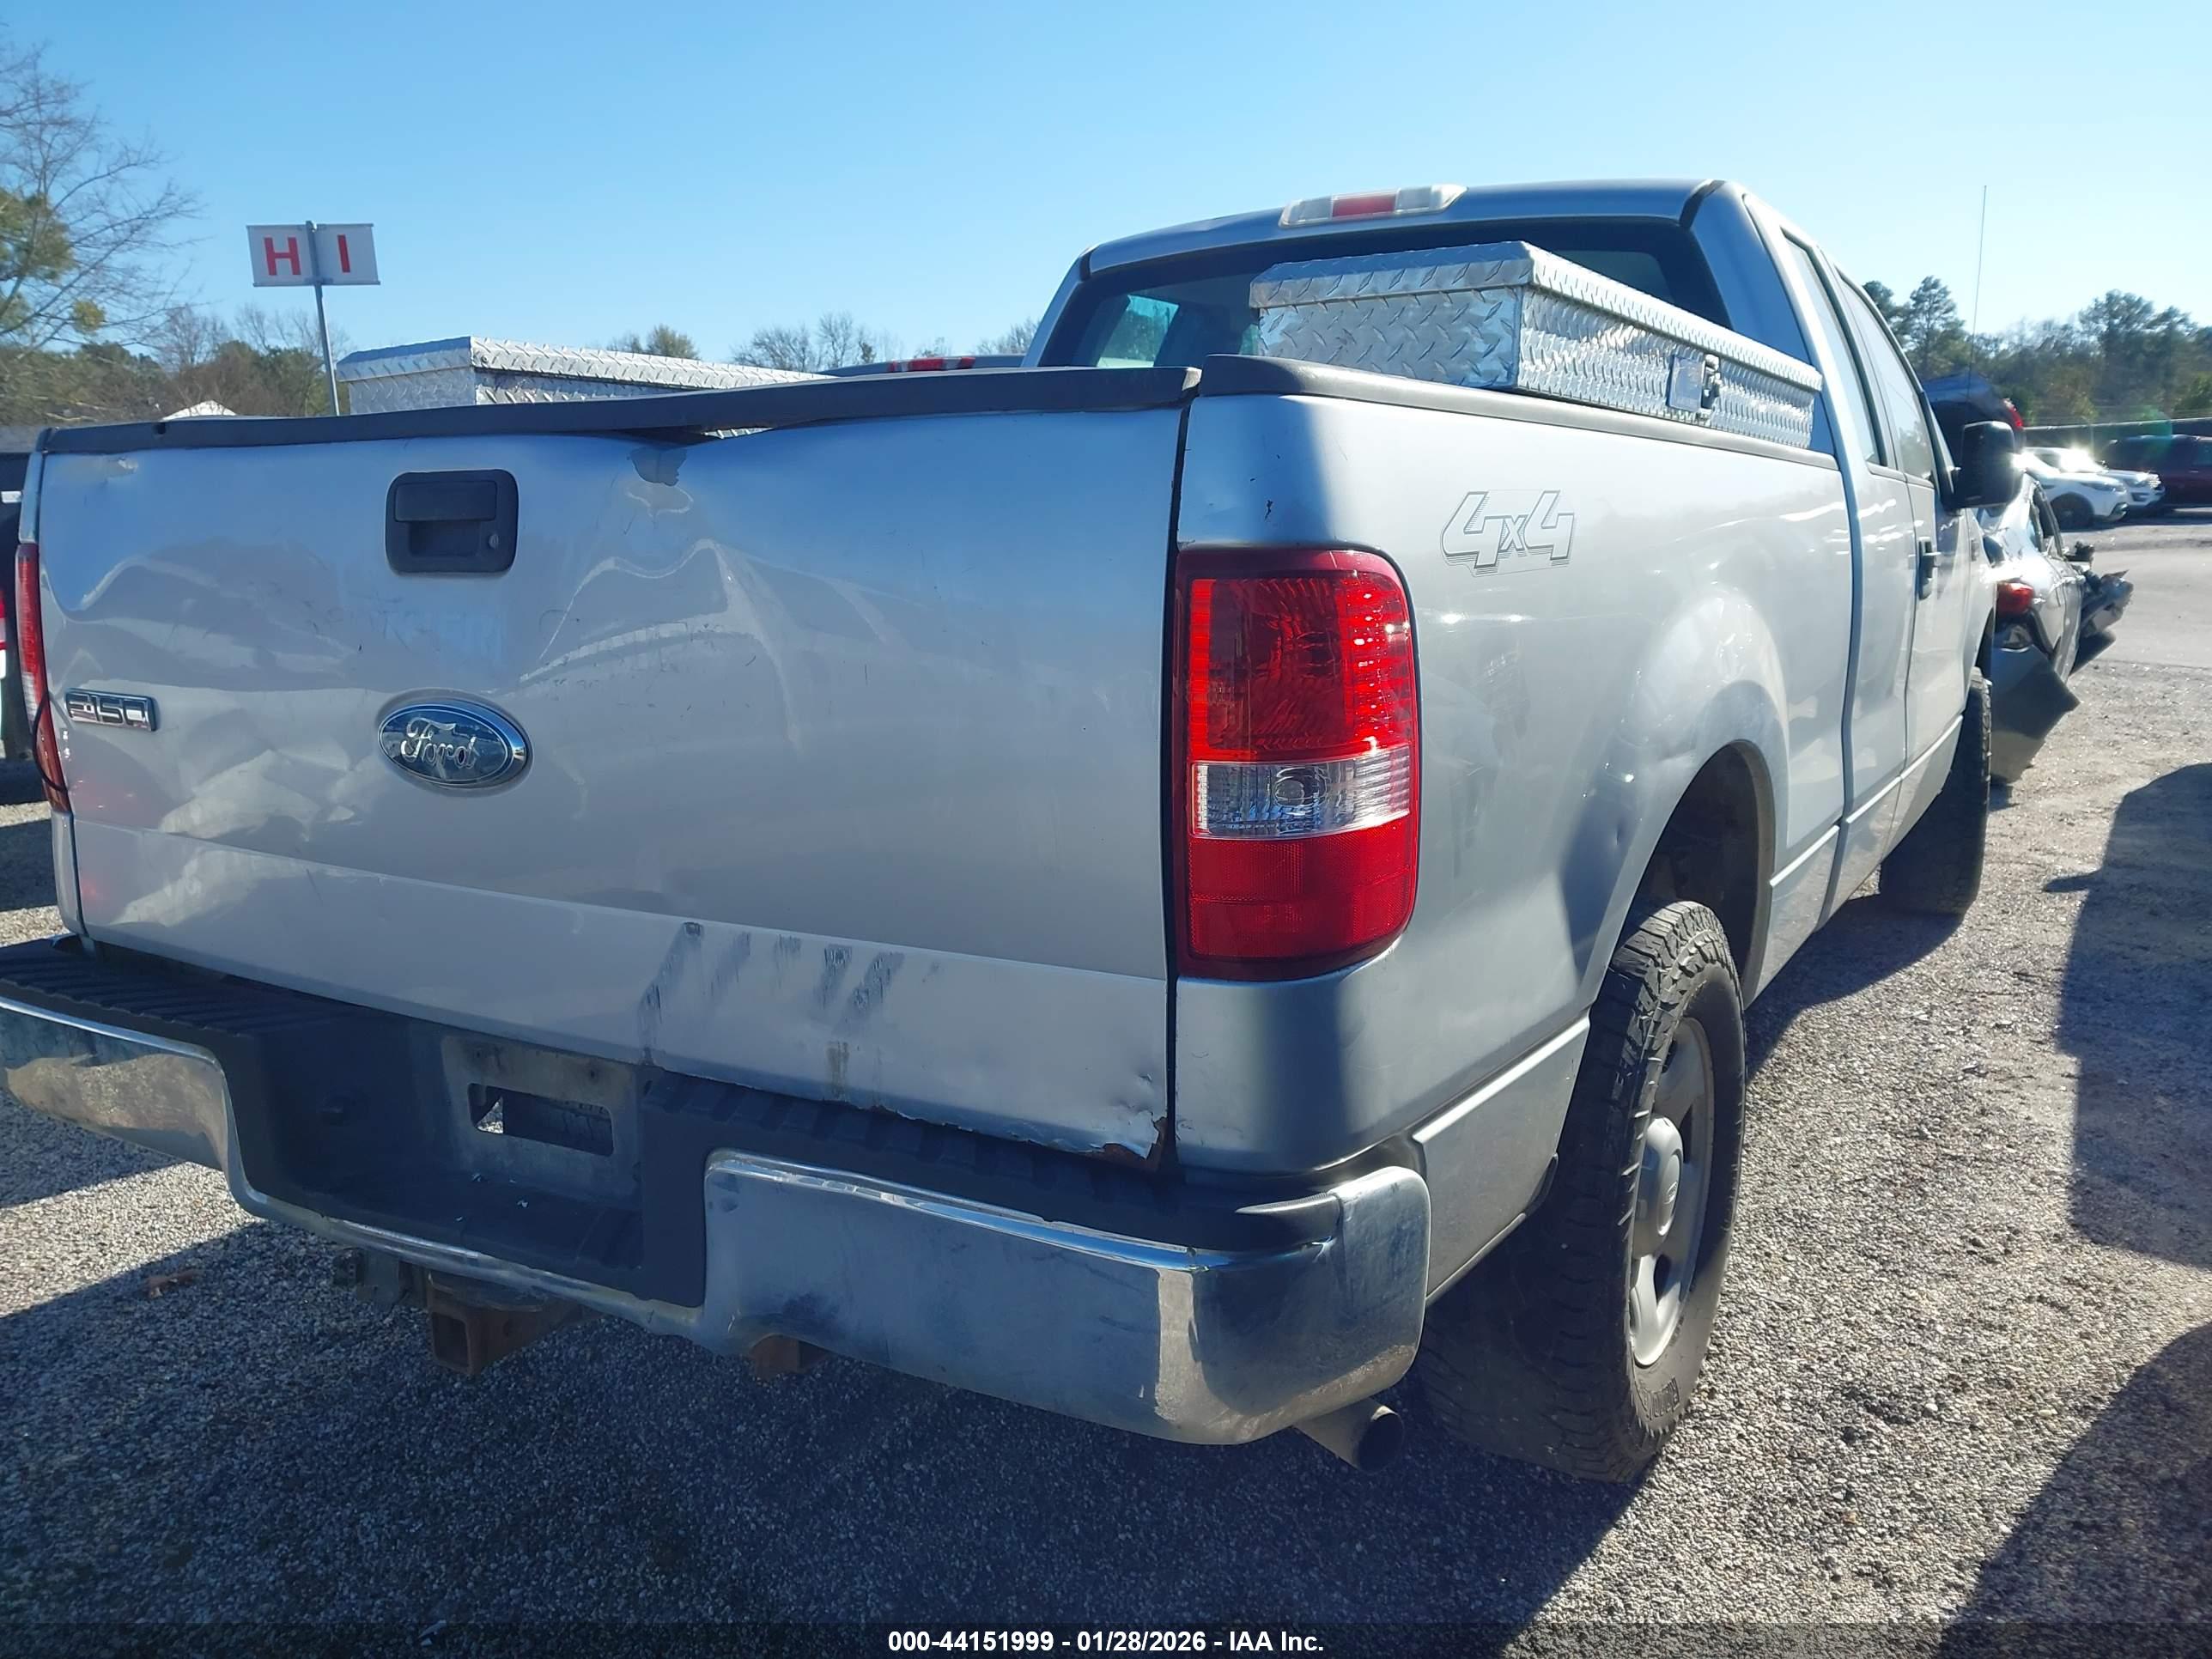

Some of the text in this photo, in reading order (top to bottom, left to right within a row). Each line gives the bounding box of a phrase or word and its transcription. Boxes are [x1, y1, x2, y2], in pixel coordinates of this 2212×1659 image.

[264, 237, 301, 276] H
[1442, 489, 1575, 575] 4x4
[400, 716, 480, 770] Ford
